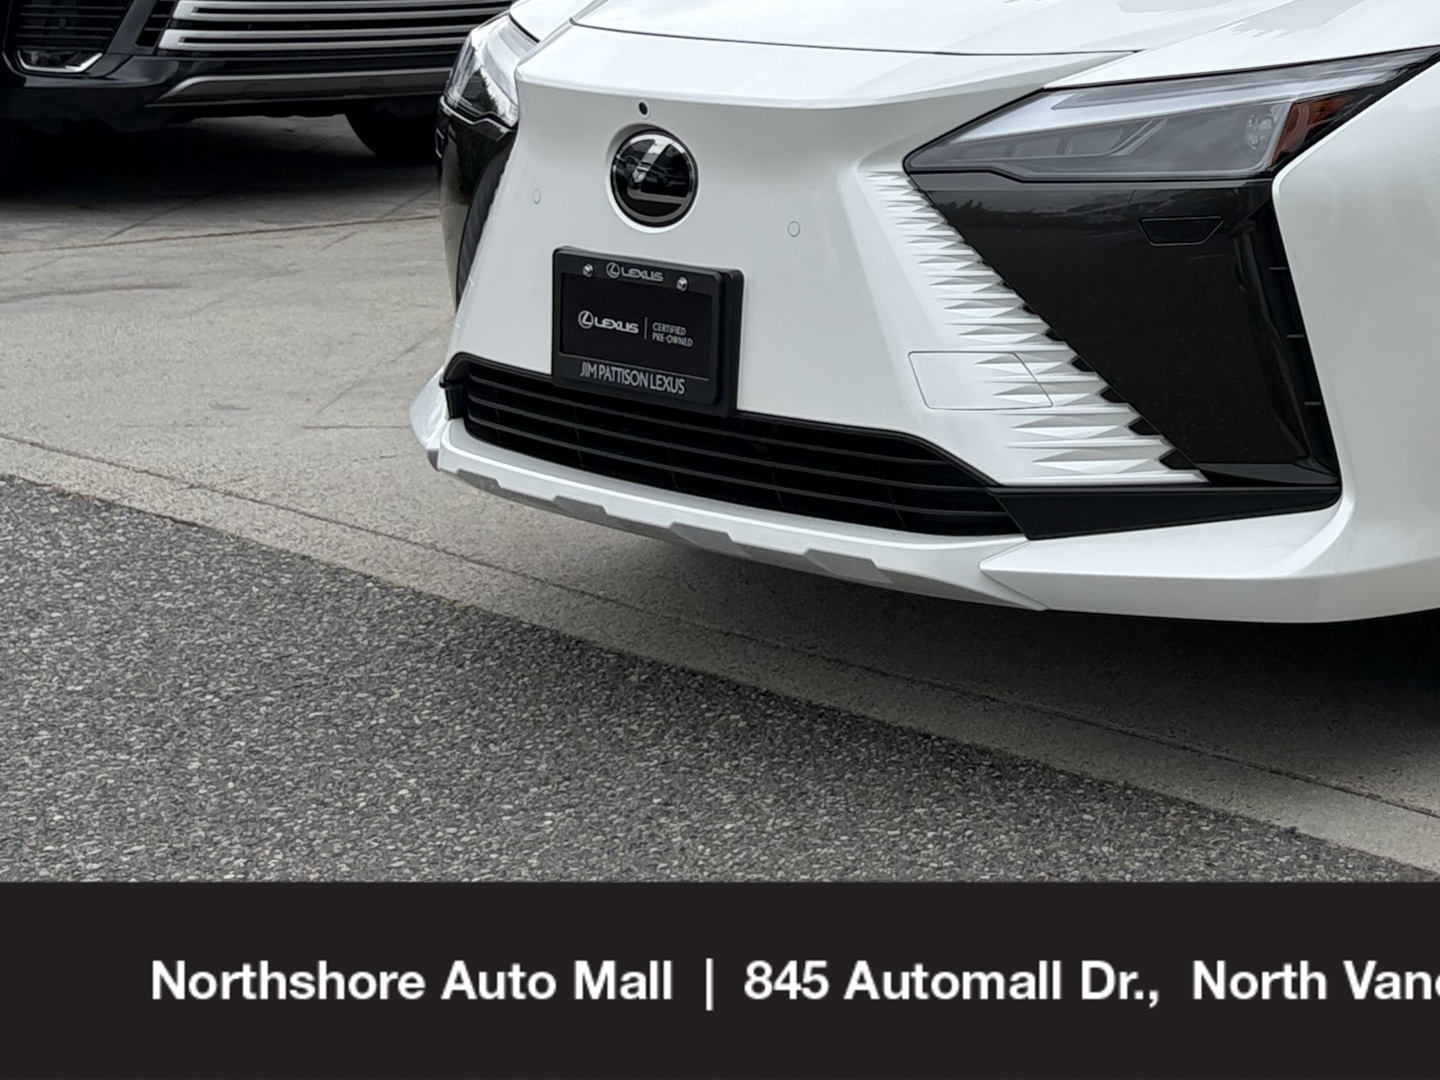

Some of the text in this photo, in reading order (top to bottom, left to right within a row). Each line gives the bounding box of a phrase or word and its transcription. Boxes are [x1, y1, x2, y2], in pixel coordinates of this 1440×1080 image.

[620, 266, 664, 282] LEXUS
[594, 316, 639, 334] LEXUS
[652, 322, 687, 336] CERTIFIED
[652, 332, 693, 347] PRE-OWNED
[580, 361, 686, 395] JIM PATTISON LEXUS
